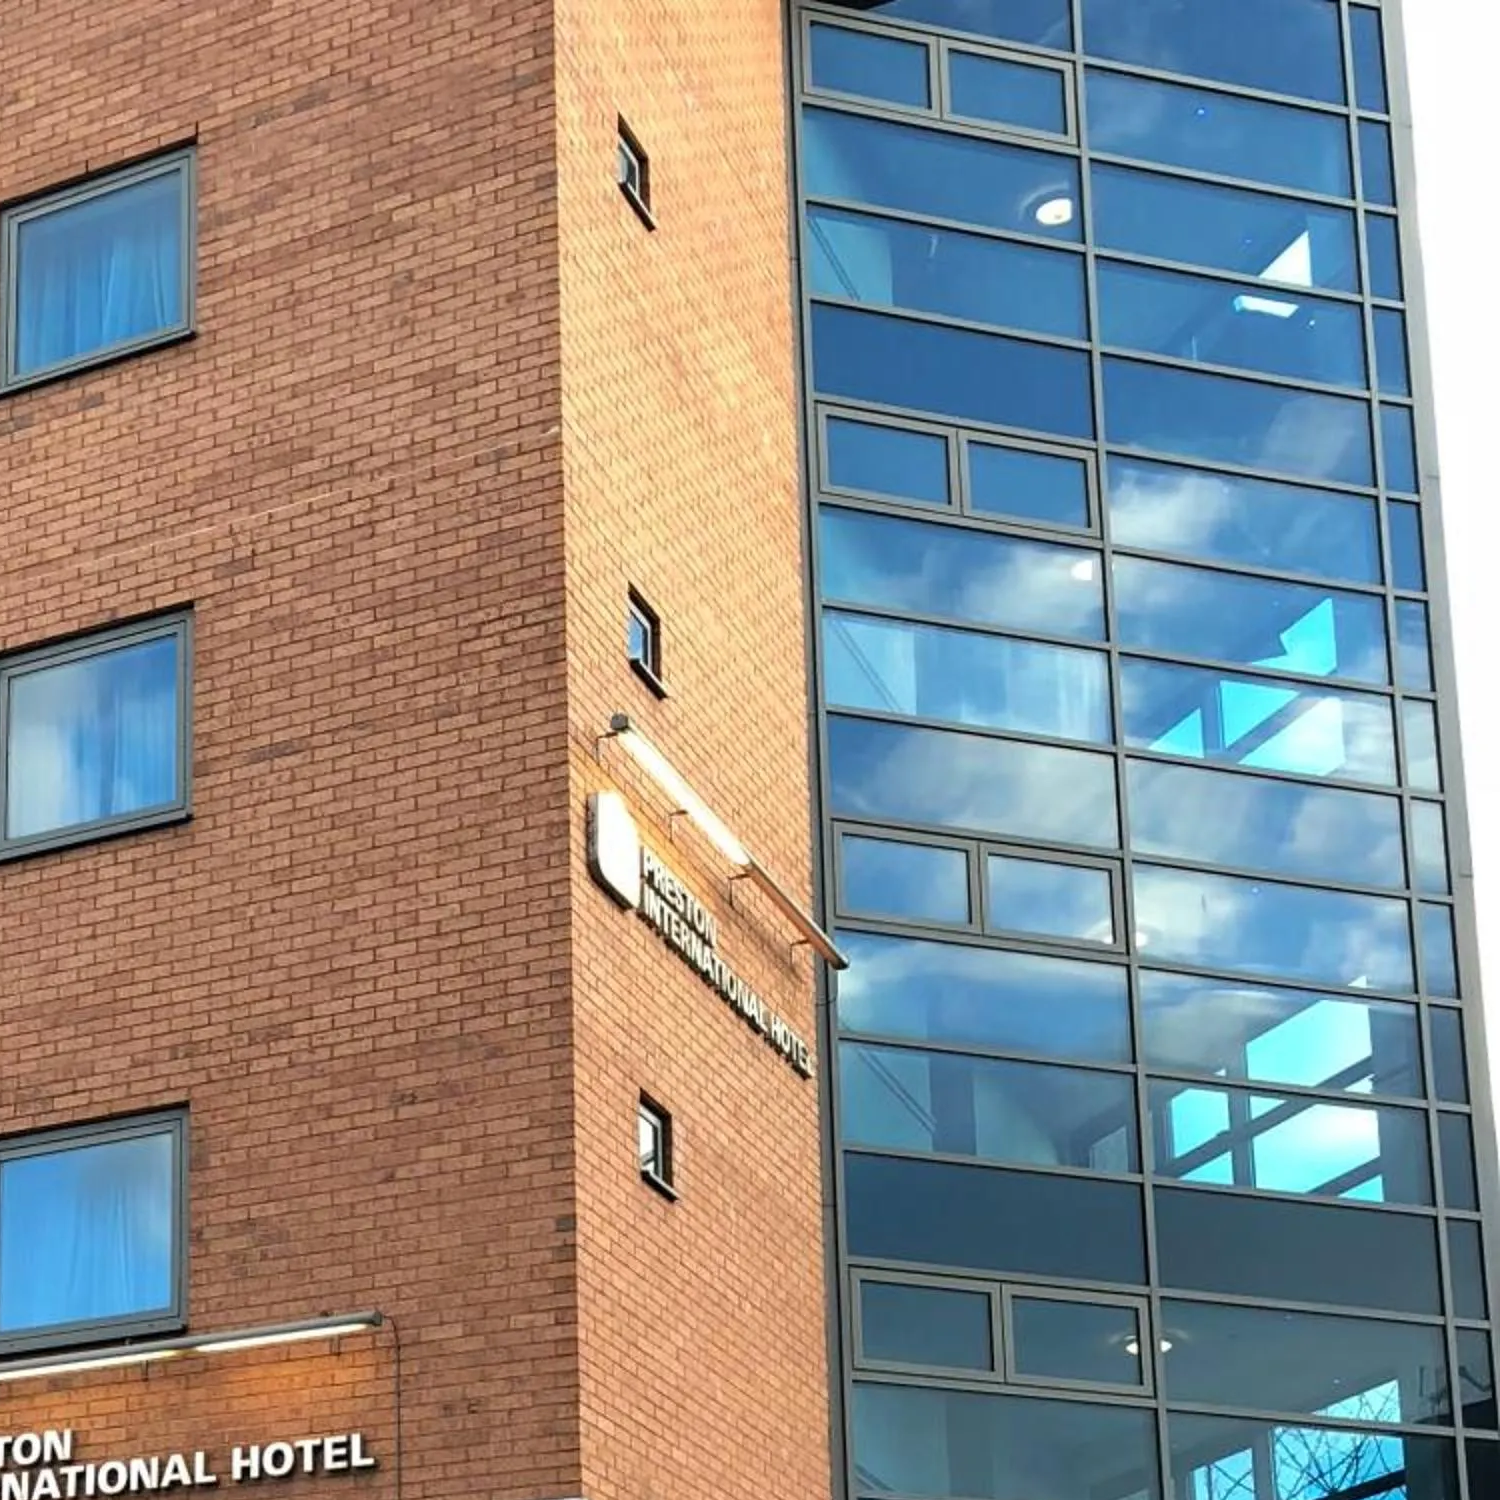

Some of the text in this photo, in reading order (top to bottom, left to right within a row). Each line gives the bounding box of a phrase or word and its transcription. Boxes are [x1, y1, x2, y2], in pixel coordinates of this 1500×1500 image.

[643, 848, 717, 947] PRESTON
[643, 884, 816, 1077] INTERNATIONAL HOTEL
[231, 1432, 375, 1482] HOTEL
